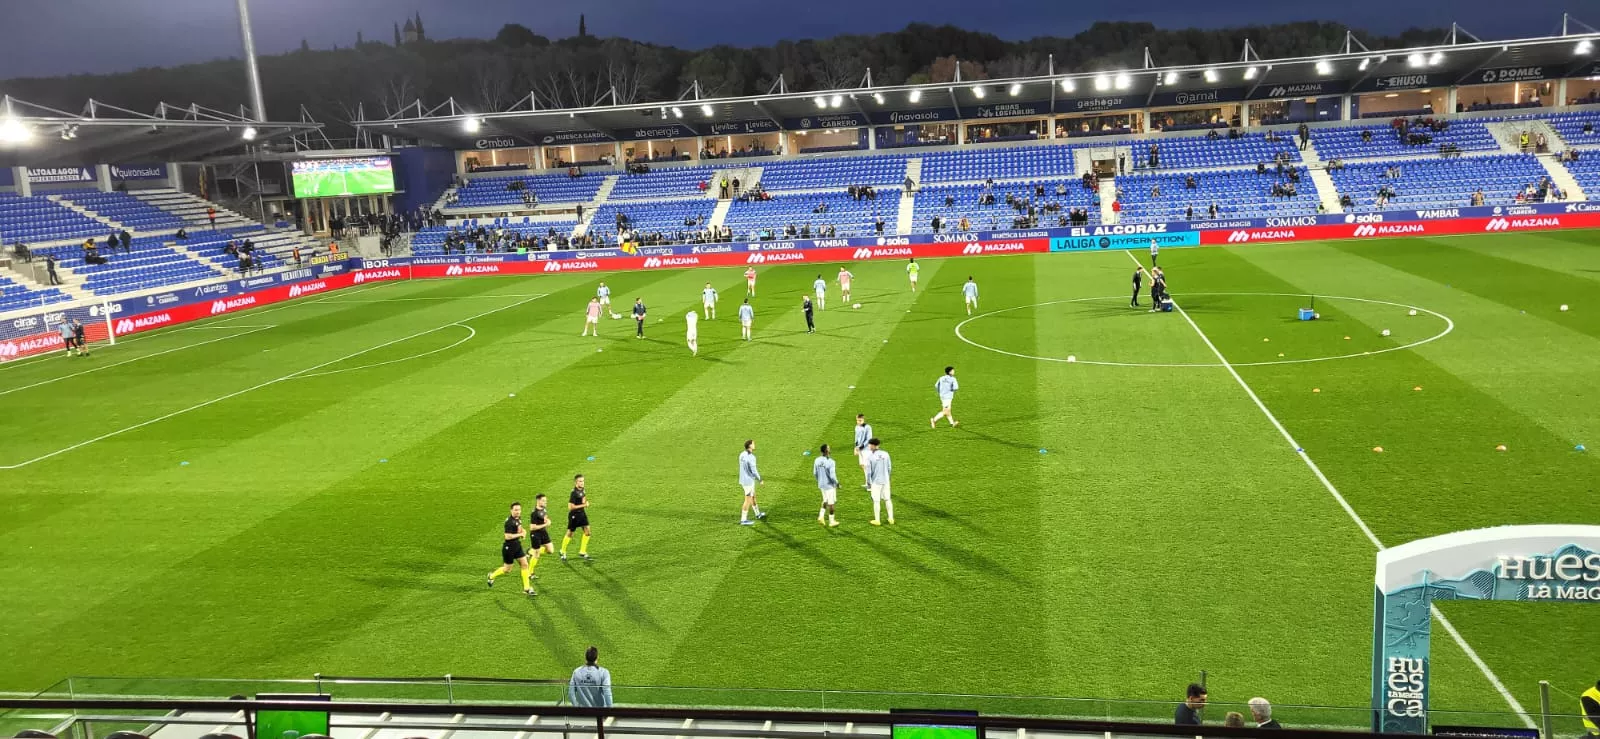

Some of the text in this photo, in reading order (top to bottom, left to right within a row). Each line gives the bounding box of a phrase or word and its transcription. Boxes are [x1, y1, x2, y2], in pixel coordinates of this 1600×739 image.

[1499, 67, 1542, 77] DOMEC
[1287, 84, 1322, 92] MAZANA
[1188, 91, 1218, 102] arnal
[898, 111, 939, 121] navasola
[821, 119, 857, 128] CABRERO
[476, 138, 514, 149] embou
[1356, 213, 1384, 223] soka
[1424, 208, 1460, 218] AMBAR
[1266, 216, 1317, 228] SOMMOS
[1511, 218, 1560, 228] MAZANA
[1071, 223, 1167, 237] EL ALCORAZ
[1378, 224, 1424, 234] MAZANA
[933, 232, 978, 243] SOMMOS
[1251, 230, 1295, 240] MAZANA
[762, 242, 795, 250] CALLIZO
[820, 239, 849, 248] AMBAR
[886, 237, 910, 246] soka
[1056, 238, 1096, 249] LALIGA
[1111, 235, 1185, 246] HYPERMOTION
[700, 245, 732, 253] CaixaBank
[873, 247, 913, 256] MAZANA
[984, 243, 1025, 251] MAZANA
[662, 257, 699, 265] MAZANA
[766, 252, 804, 261] MAZANA
[464, 265, 499, 273] MAZANA
[562, 261, 598, 269] MAZANA
[364, 269, 401, 279] MAZANA
[301, 282, 327, 293] MAZANA
[227, 296, 256, 309] MAZANA
[13, 316, 38, 329] cirac
[135, 313, 171, 328] MAZANA
[19, 335, 64, 352] MAZANA
